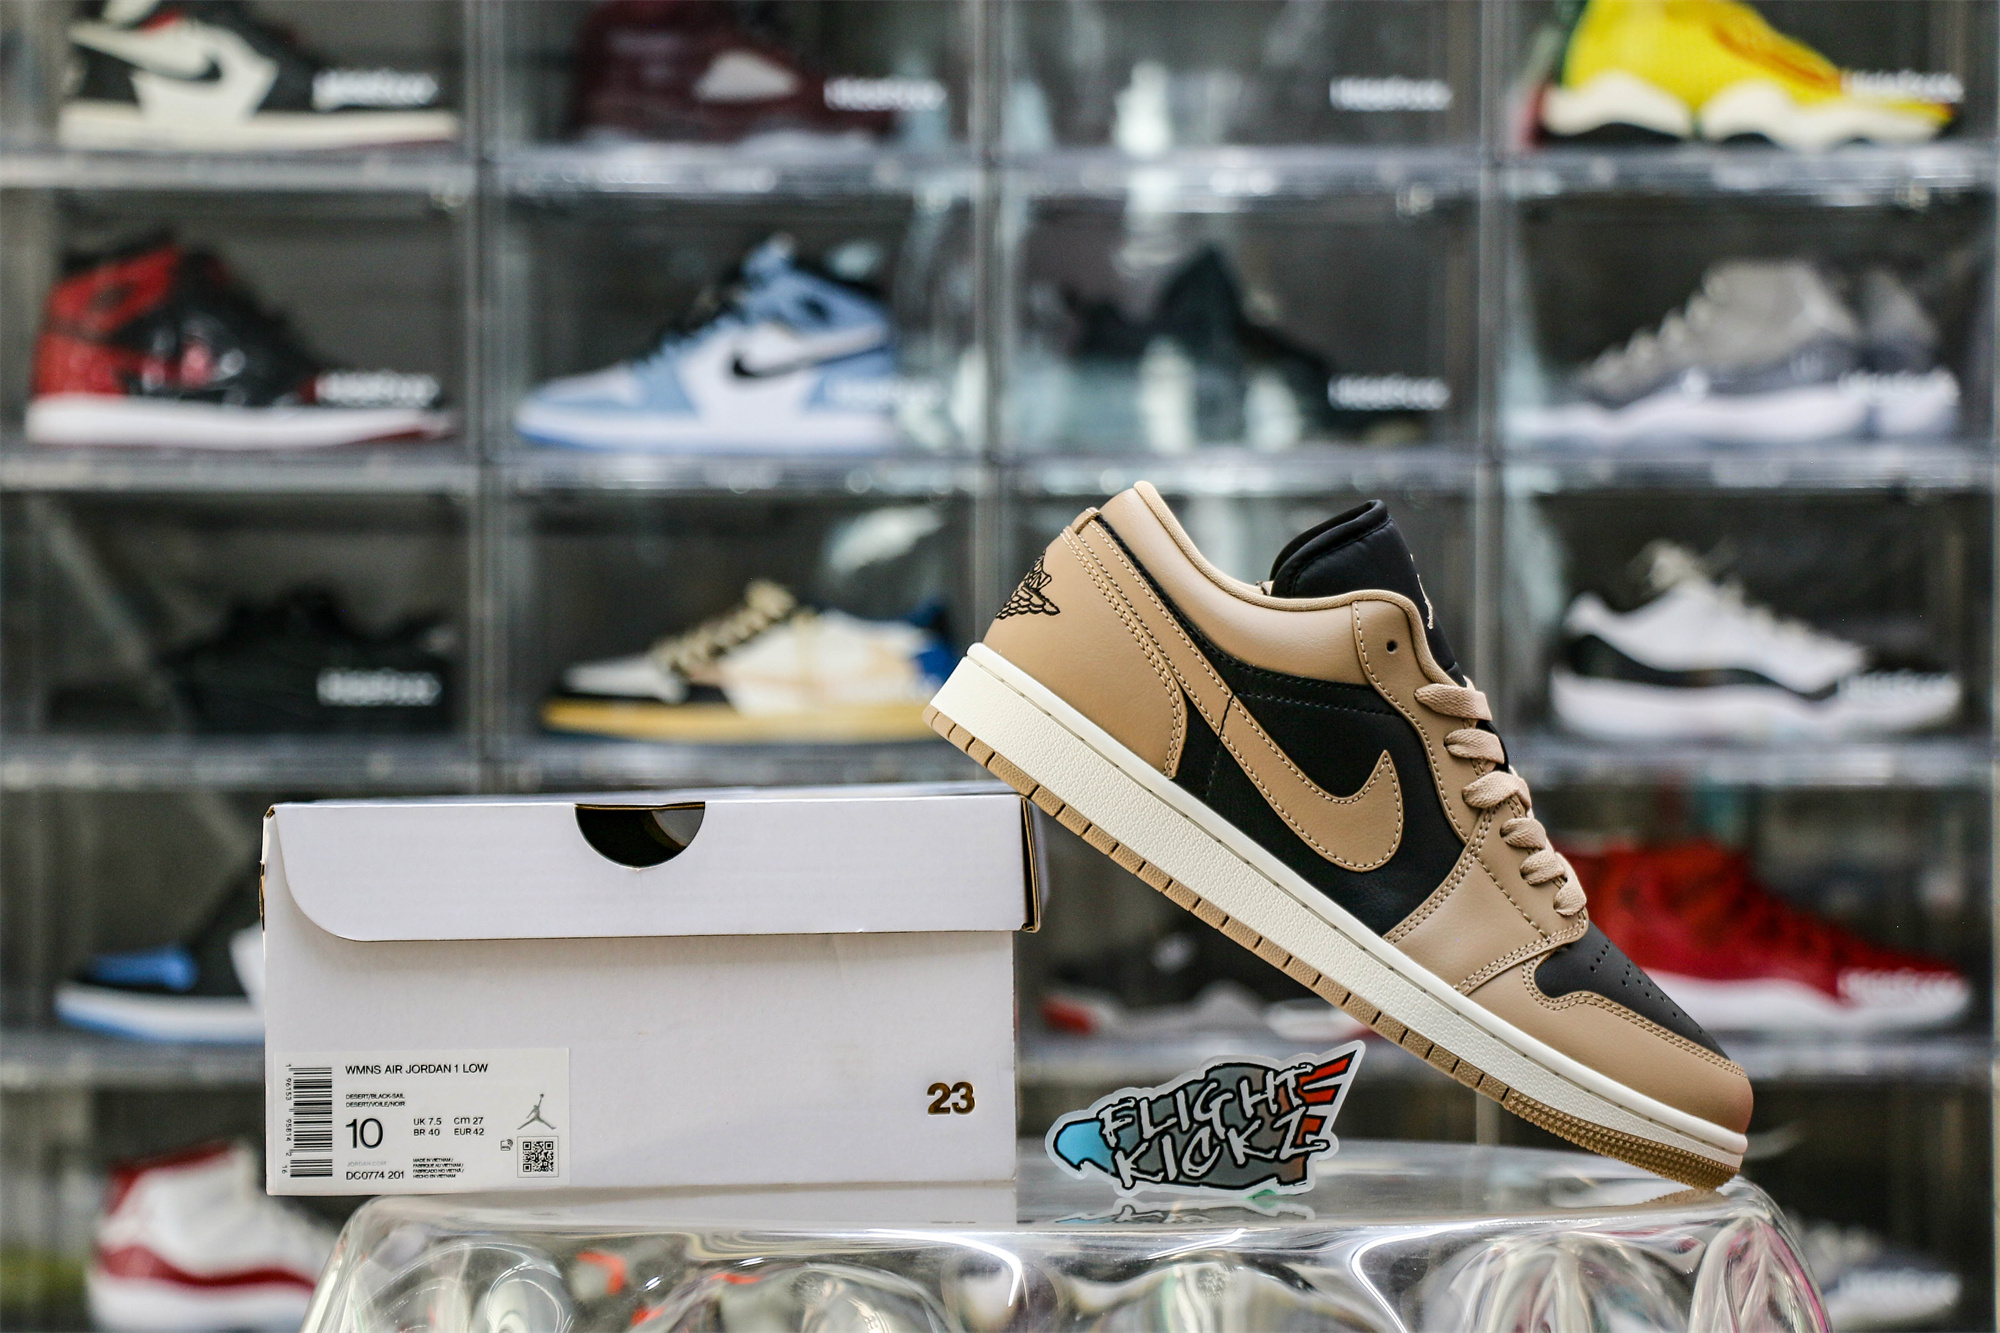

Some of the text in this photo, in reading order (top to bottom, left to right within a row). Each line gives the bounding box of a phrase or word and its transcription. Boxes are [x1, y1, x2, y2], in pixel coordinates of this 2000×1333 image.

[345, 1063, 489, 1074] WMNS AIR JORDAN 1 LOW
[927, 1081, 975, 1115] 23
[1097, 1063, 1313, 1146] FLIGHT
[413, 1117, 442, 1126] UK 7.5
[472, 1117, 484, 1125] 27
[345, 1117, 384, 1149] 10
[413, 1128, 441, 1136] BR 40
[453, 1128, 485, 1136] EUR 42
[1113, 1107, 1331, 1189] KICKZ
[345, 1170, 405, 1180] DC0774 201
